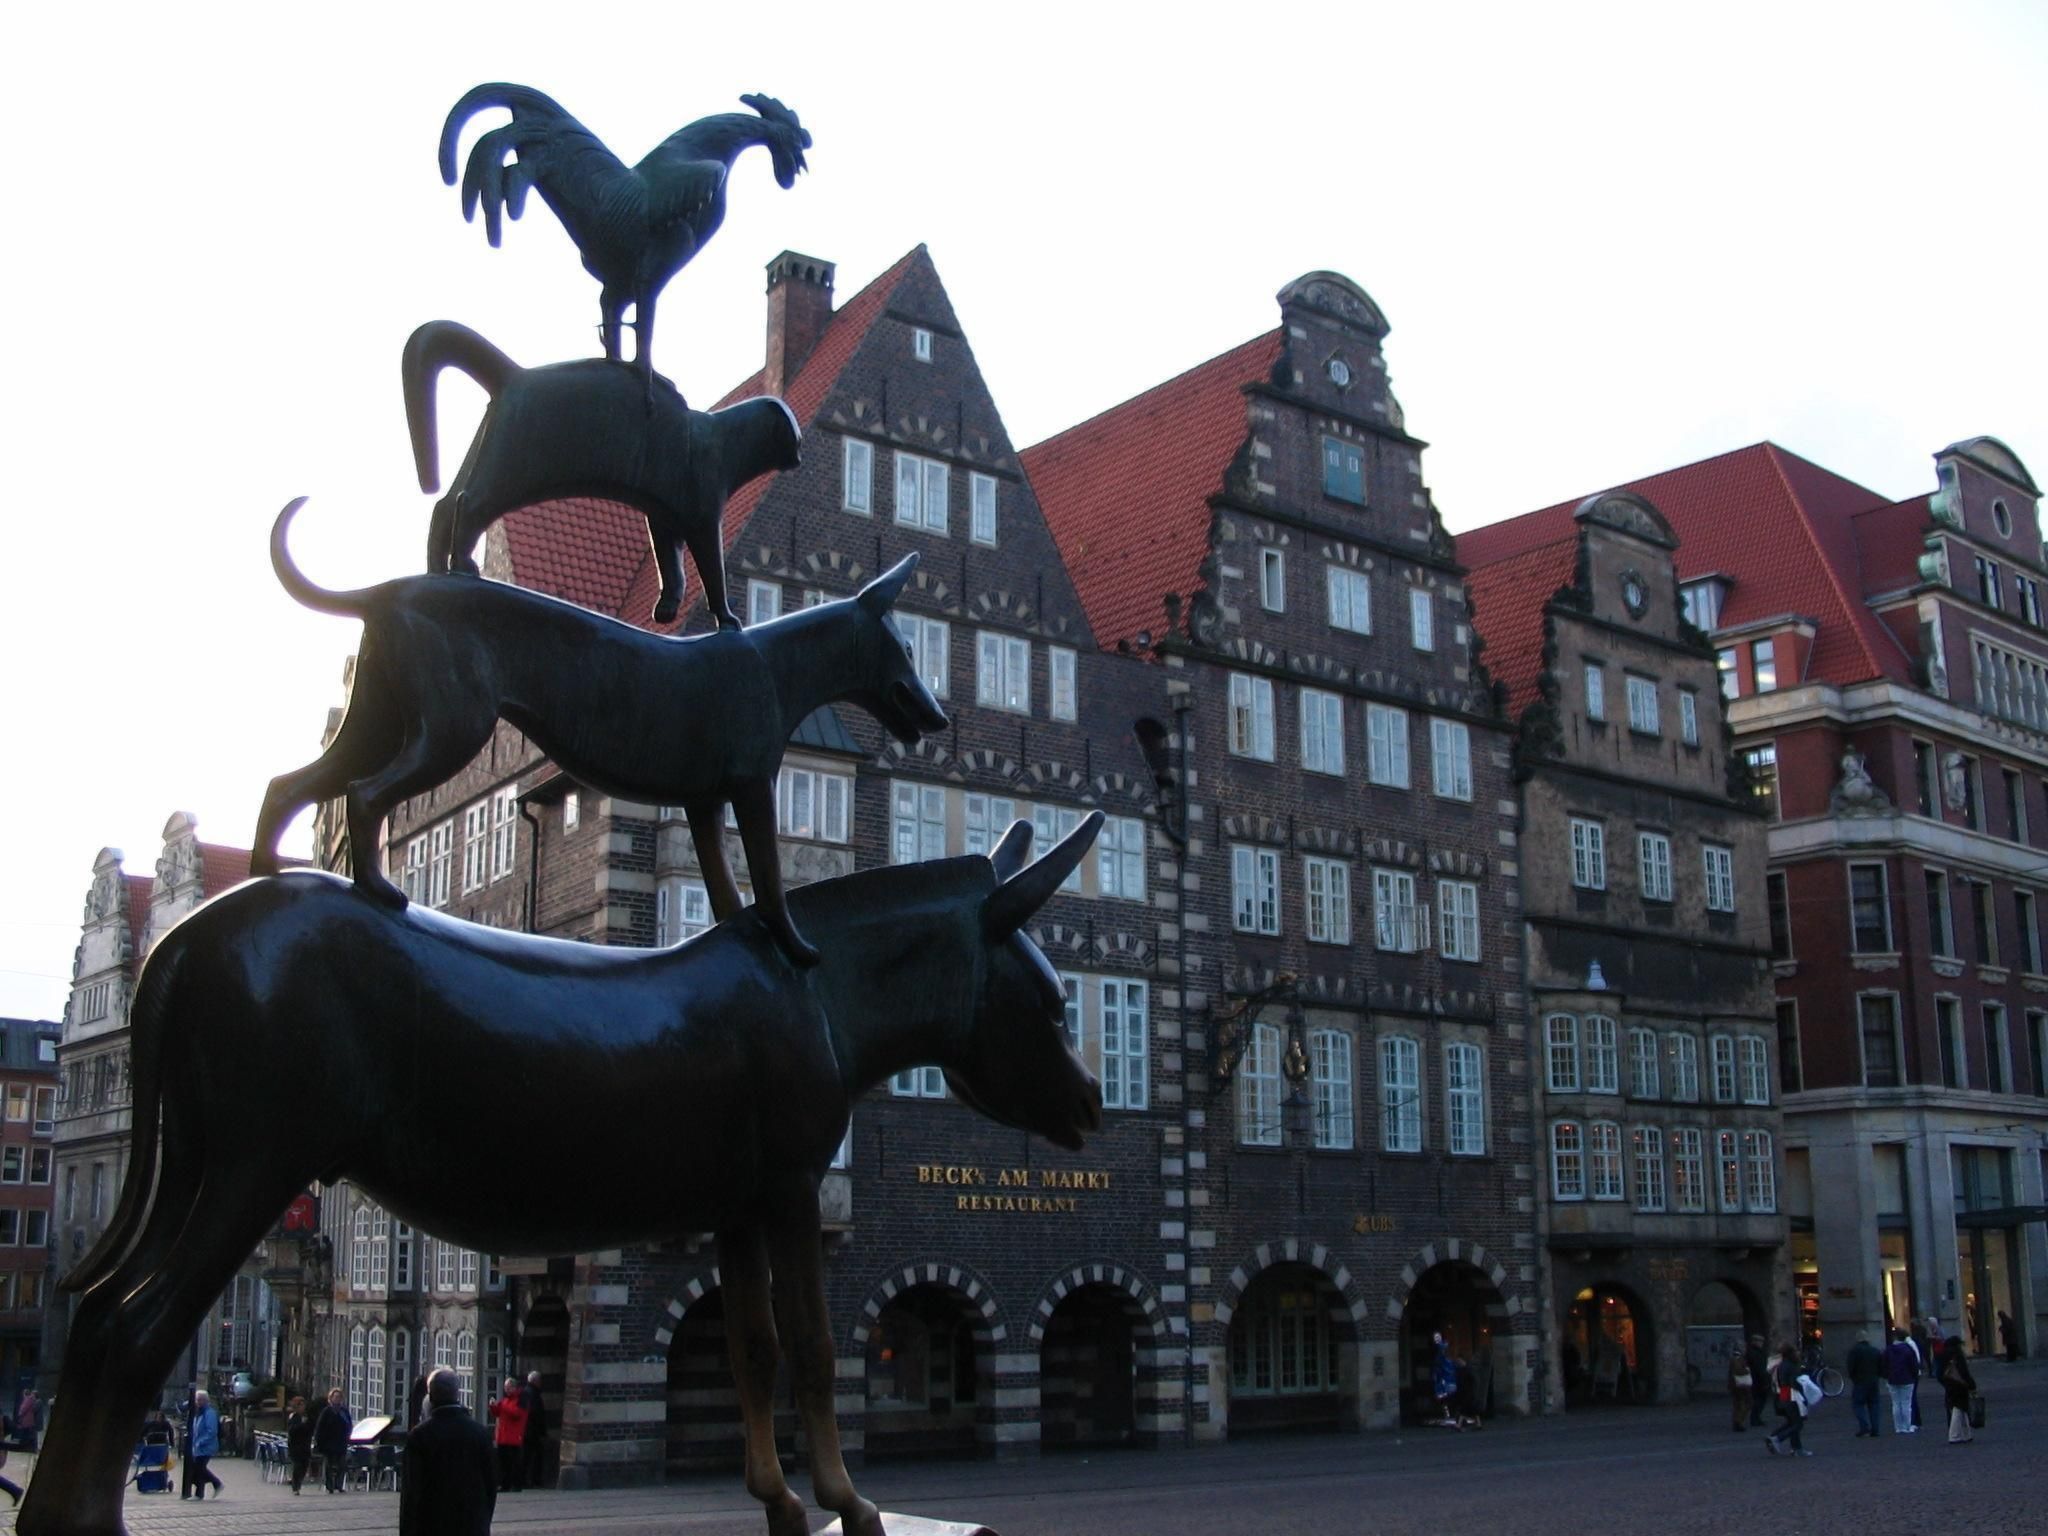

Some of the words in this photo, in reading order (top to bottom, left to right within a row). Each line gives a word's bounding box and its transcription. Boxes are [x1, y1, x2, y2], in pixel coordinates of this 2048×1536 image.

[997, 1169, 1028, 1186] AM
[1041, 1171, 1110, 1188] MARKT
[957, 1195, 1076, 1211] RESTAURANT
[1370, 1215, 1395, 1232] UBS
